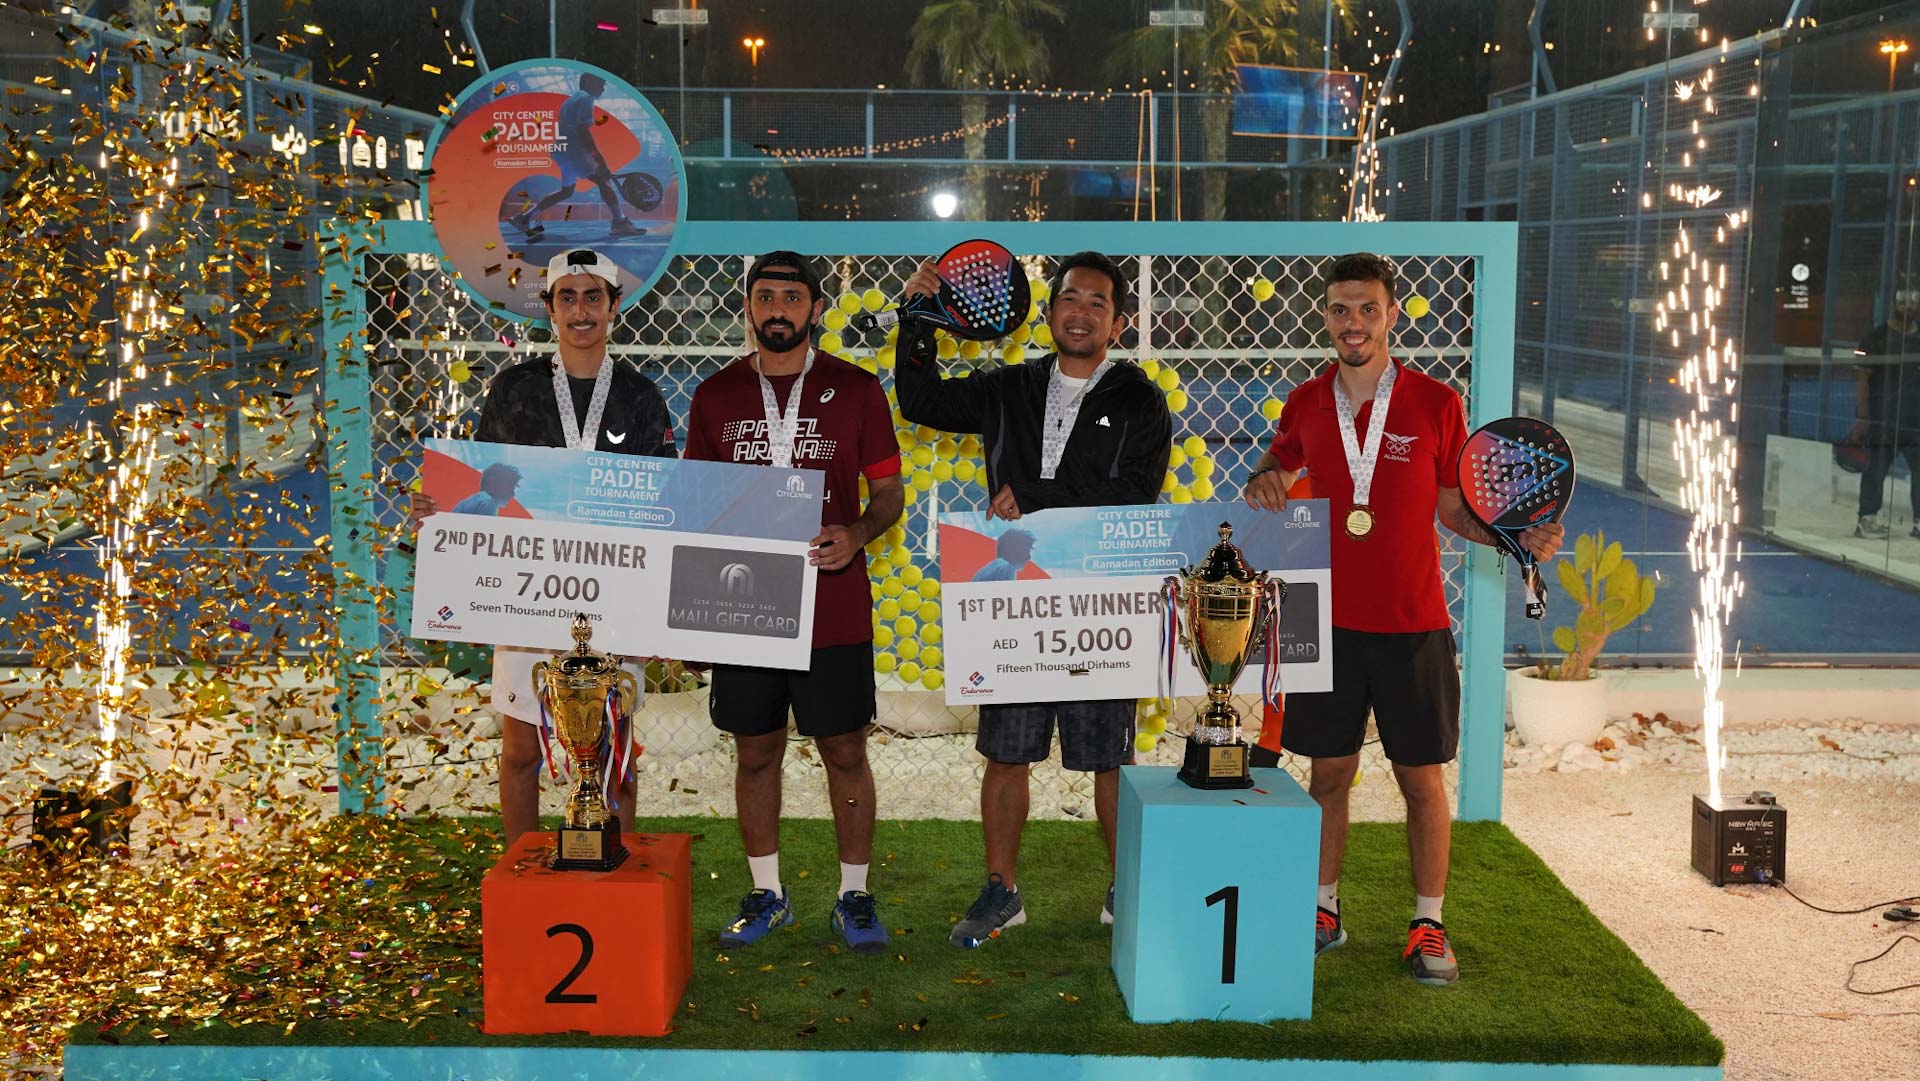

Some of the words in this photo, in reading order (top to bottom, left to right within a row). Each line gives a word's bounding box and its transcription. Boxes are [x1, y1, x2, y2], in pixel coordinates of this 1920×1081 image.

[492, 111, 514, 120] CITY
[516, 110, 555, 120] CENTRE
[493, 121, 568, 141] PADEL
[495, 142, 568, 153] TOURNAMENT
[586, 456, 614, 467] CITY
[616, 458, 663, 471] CENTRE
[1383, 453, 1411, 463] ALBANIA
[590, 467, 658, 491] PADEL
[584, 486, 661, 501] TOURNAMENT
[577, 505, 626, 519] Ramadan
[628, 510, 665, 521] Edition
[1097, 511, 1122, 520] CITY
[1125, 509, 1172, 519] CENTRE
[1102, 520, 1169, 540] PADEL
[433, 528, 468, 553] 2ND
[472, 532, 545, 561] PLACE
[552, 538, 647, 569] WINNER
[1098, 538, 1172, 550] TOURNAMENT
[1093, 558, 1140, 569] Ramadan
[1143, 557, 1178, 567] Edition
[475, 576, 502, 588] AED
[517, 571, 600, 602] 7,000
[469, 602, 501, 613] Seven
[504, 604, 556, 618] Thousand
[957, 598, 985, 621] 1ST
[991, 594, 1063, 620] PLACE
[1068, 591, 1162, 617] WINNER
[671, 607, 712, 625] MALL
[715, 611, 751, 628] GIFT
[753, 615, 797, 632] CARD
[993, 638, 1018, 650] AED
[1033, 627, 1133, 657] 15,000
[996, 663, 1032, 674] Fifteen
[1035, 660, 1085, 672] Thousand
[1088, 659, 1131, 670] Dirhams
[1205, 886, 1239, 984] 1
[545, 923, 598, 1004] 2
